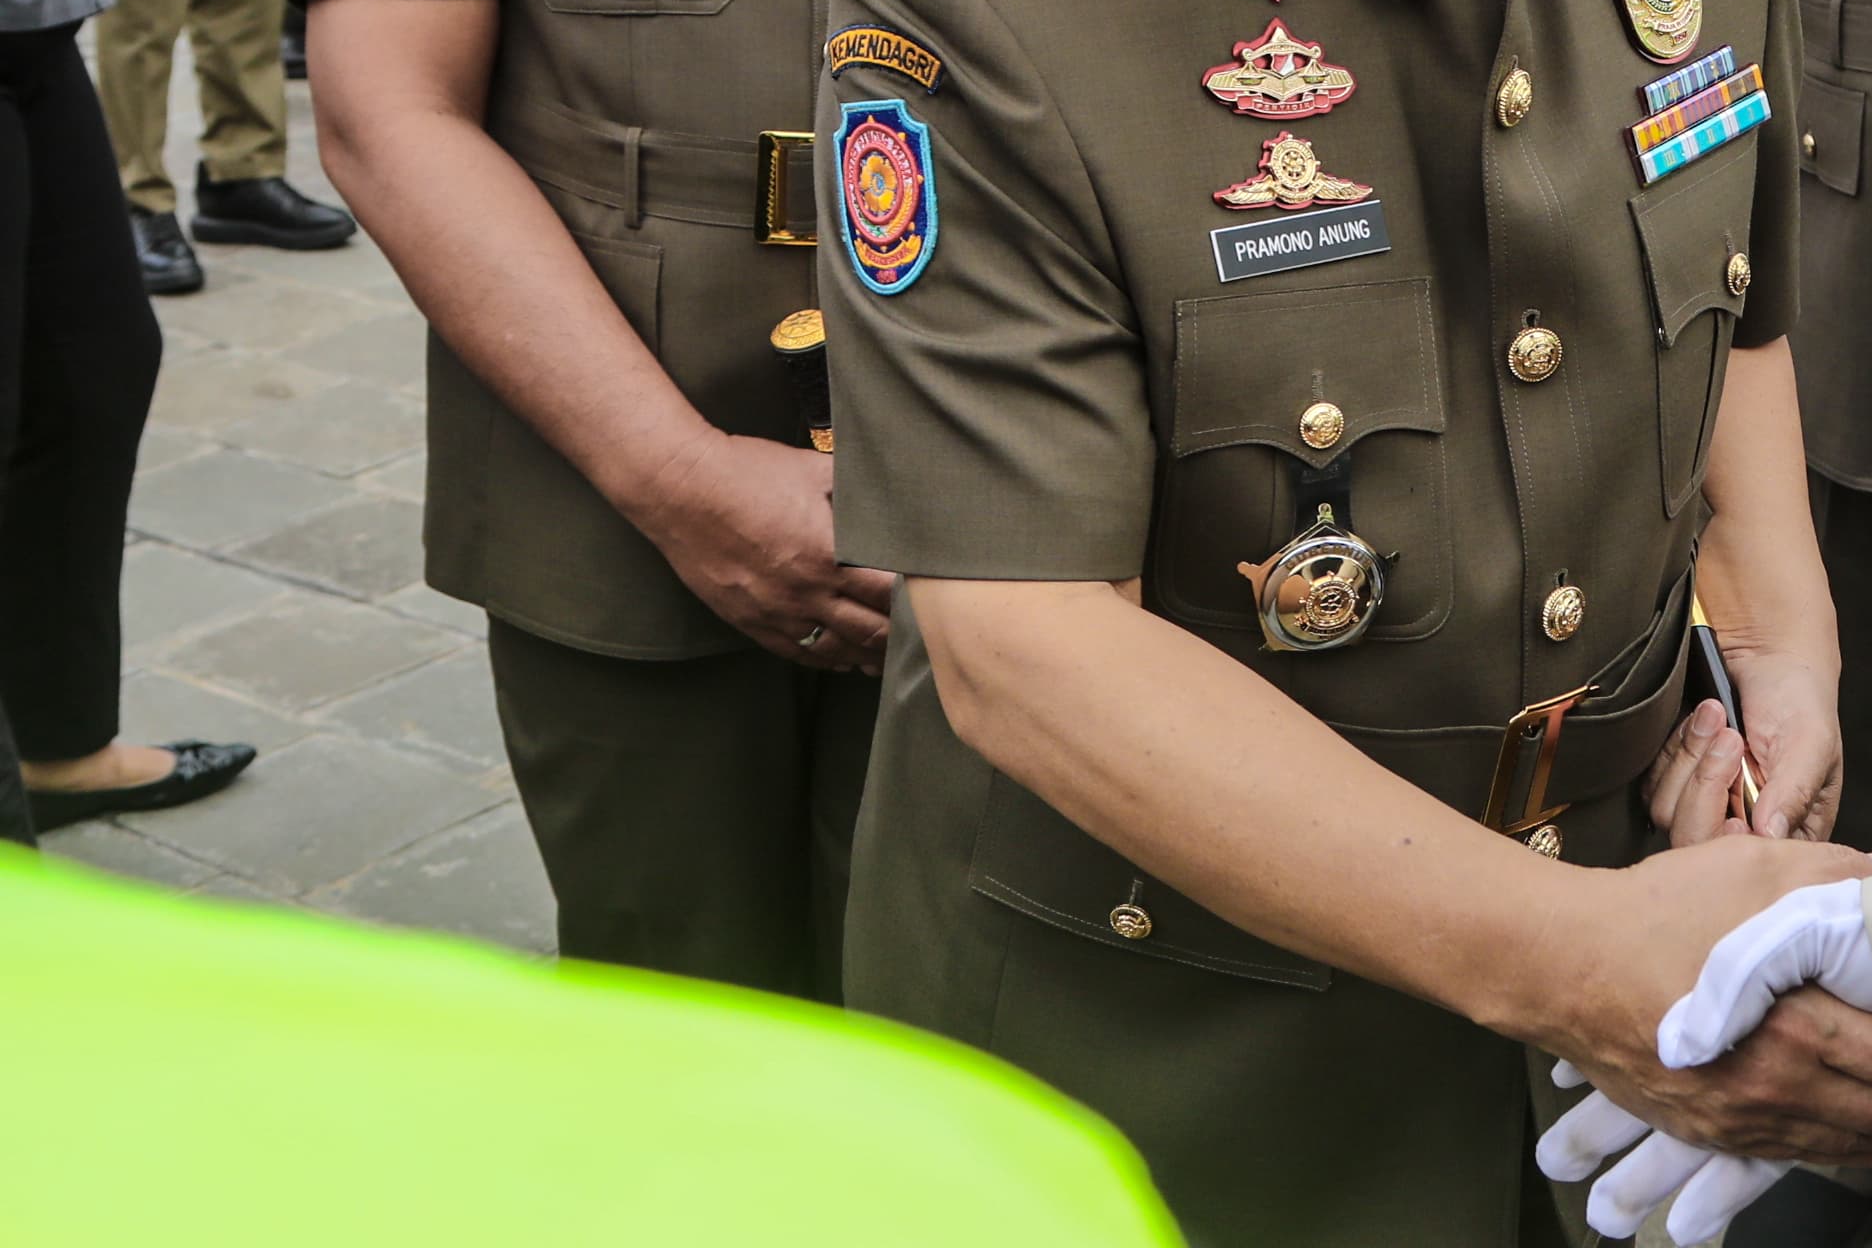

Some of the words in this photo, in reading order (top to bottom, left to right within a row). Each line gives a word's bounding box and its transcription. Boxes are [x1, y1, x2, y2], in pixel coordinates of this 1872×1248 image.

[831, 33, 934, 81] KEMENDAGRI
[1234, 230, 1313, 262] PRAMONO
[1319, 219, 1371, 247] ANUNG
